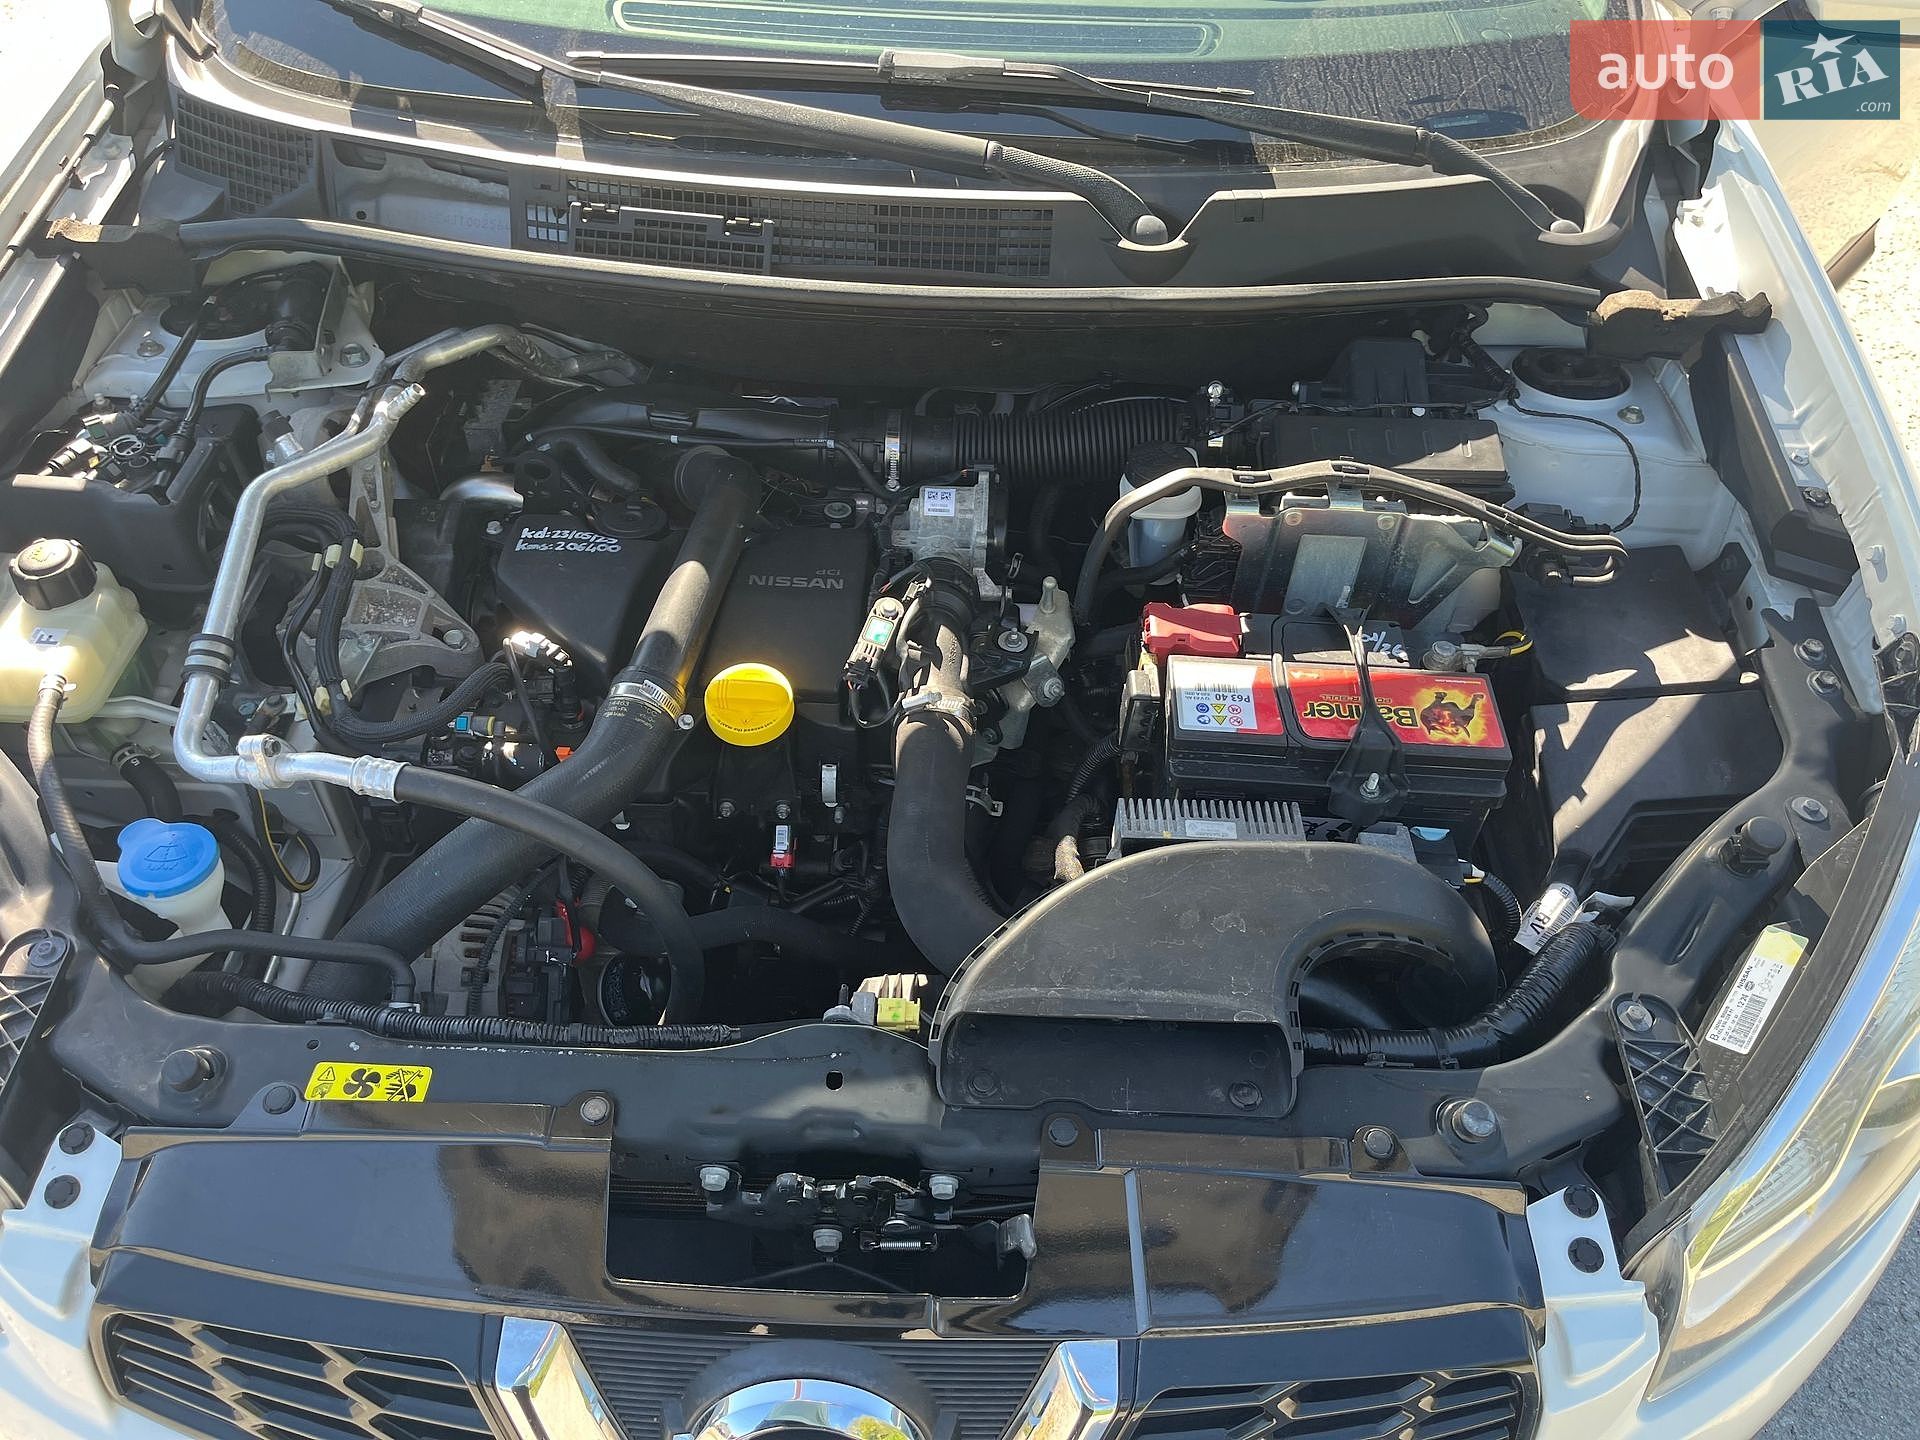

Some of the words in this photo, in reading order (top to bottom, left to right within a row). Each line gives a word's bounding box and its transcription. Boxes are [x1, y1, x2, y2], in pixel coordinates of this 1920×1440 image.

[748, 575, 844, 589] NISSAN
[1215, 692, 1228, 701] 40
[1231, 693, 1250, 703] P63
[1736, 965, 1753, 989] NISSAN
